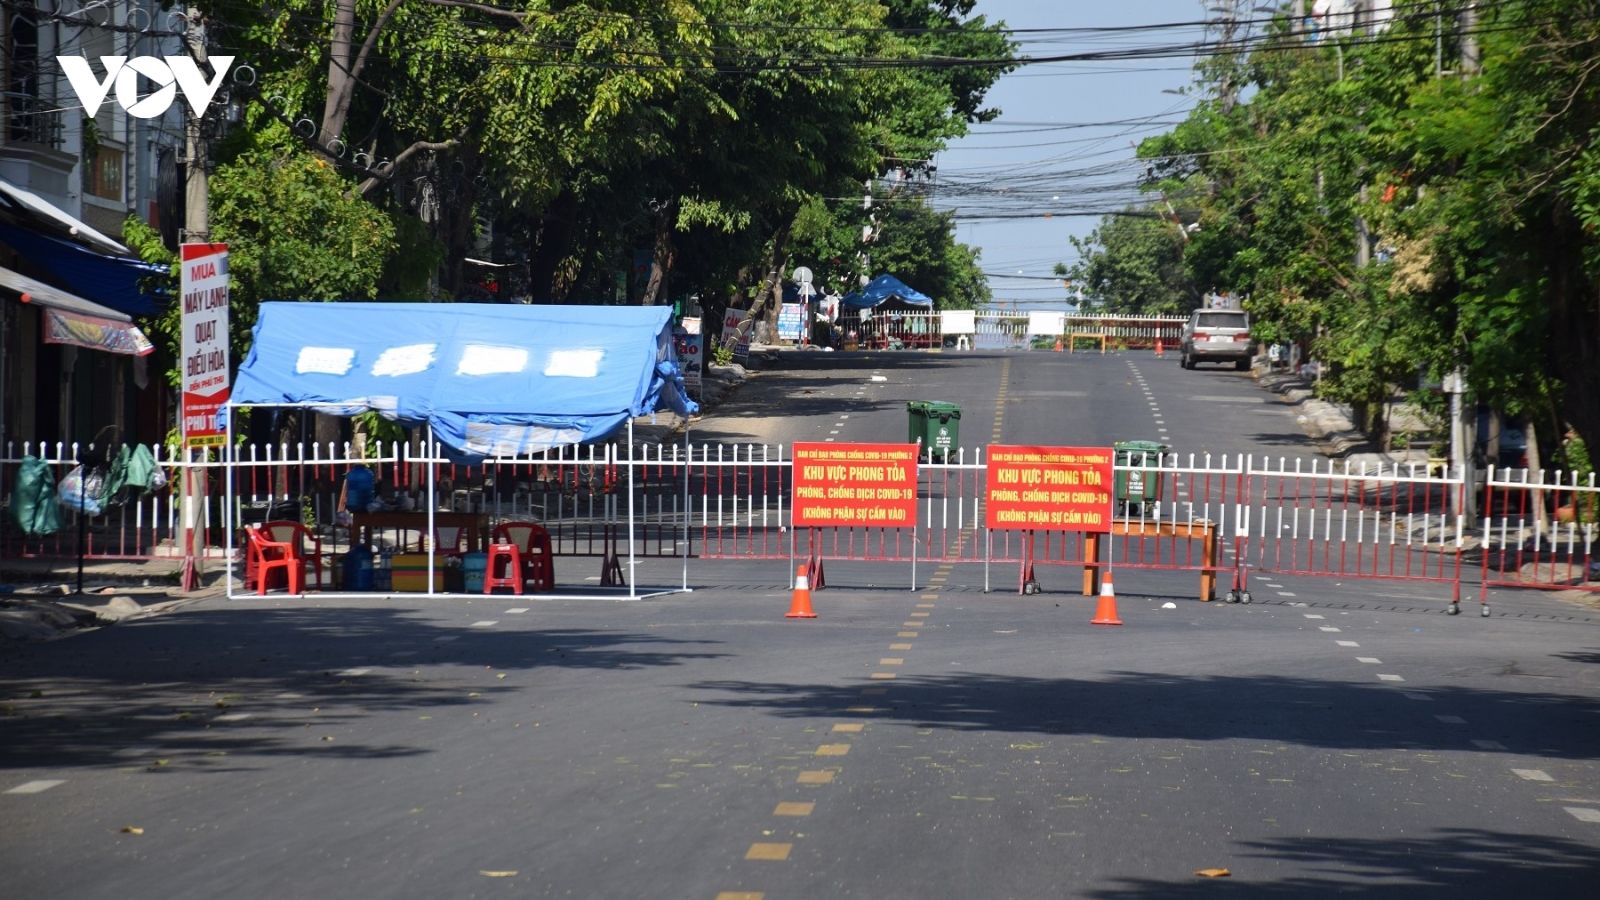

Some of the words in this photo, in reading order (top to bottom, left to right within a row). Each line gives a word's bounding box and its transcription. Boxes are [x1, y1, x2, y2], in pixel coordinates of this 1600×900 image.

[191, 262, 216, 282] MUA
[185, 288, 203, 314] MÁY
[205, 285, 227, 313] LẠNH
[195, 319, 217, 345] QUẠT
[187, 348, 206, 377] ĐIỀU
[207, 347, 225, 372] HÒA
[189, 379, 200, 391] ĐẾN
[201, 376, 213, 388] PHÚ
[187, 412, 206, 431] PHÚ
[797, 450, 808, 458] BAN
[809, 448, 818, 458] CHỈ
[829, 450, 846, 459] PHÒNG
[847, 449, 864, 459] CHỐNG
[865, 452, 887, 460] COVID-19
[888, 451, 908, 460] PHƯỜNG
[909, 452, 913, 460] 2
[992, 453, 1003, 461] BAN
[1004, 452, 1013, 461] CHỈ
[1024, 453, 1041, 462] PHÒNG
[1043, 453, 1059, 462] CHỐNG
[1060, 455, 1082, 463] COVID-19
[1083, 454, 1104, 463] PHƯỜNG
[1105, 456, 1109, 464] 2
[803, 465, 825, 480] KHU
[827, 465, 847, 483] VỰC
[849, 466, 884, 481] PHONG
[886, 462, 906, 481] TỎA
[998, 469, 1019, 483] KHU
[1021, 468, 1041, 487] VỰC
[1044, 469, 1079, 485] PHONG
[1082, 466, 1101, 485] TỎA
[797, 484, 826, 500] PHÒNG,
[828, 484, 855, 499] CHỐNG
[856, 488, 875, 501] DỊCH
[877, 488, 913, 499] COVID-19
[991, 488, 1020, 503] PHÒNG,
[1022, 488, 1049, 502] CHỐNG
[1051, 492, 1070, 505] DỊCH
[1072, 492, 1108, 504] COVID-19
[803, 506, 831, 519] (KHÔNG
[833, 506, 854, 521] PHẬN
[856, 507, 868, 521] SỰ
[869, 505, 886, 520] CẤM
[888, 506, 906, 521] VÀO)
[997, 508, 1026, 523] (KHÔNG
[1028, 509, 1049, 525] PHẬN
[1051, 511, 1063, 525] SỰ
[1063, 509, 1081, 524] CẤM
[1083, 510, 1101, 526] VÀO)
